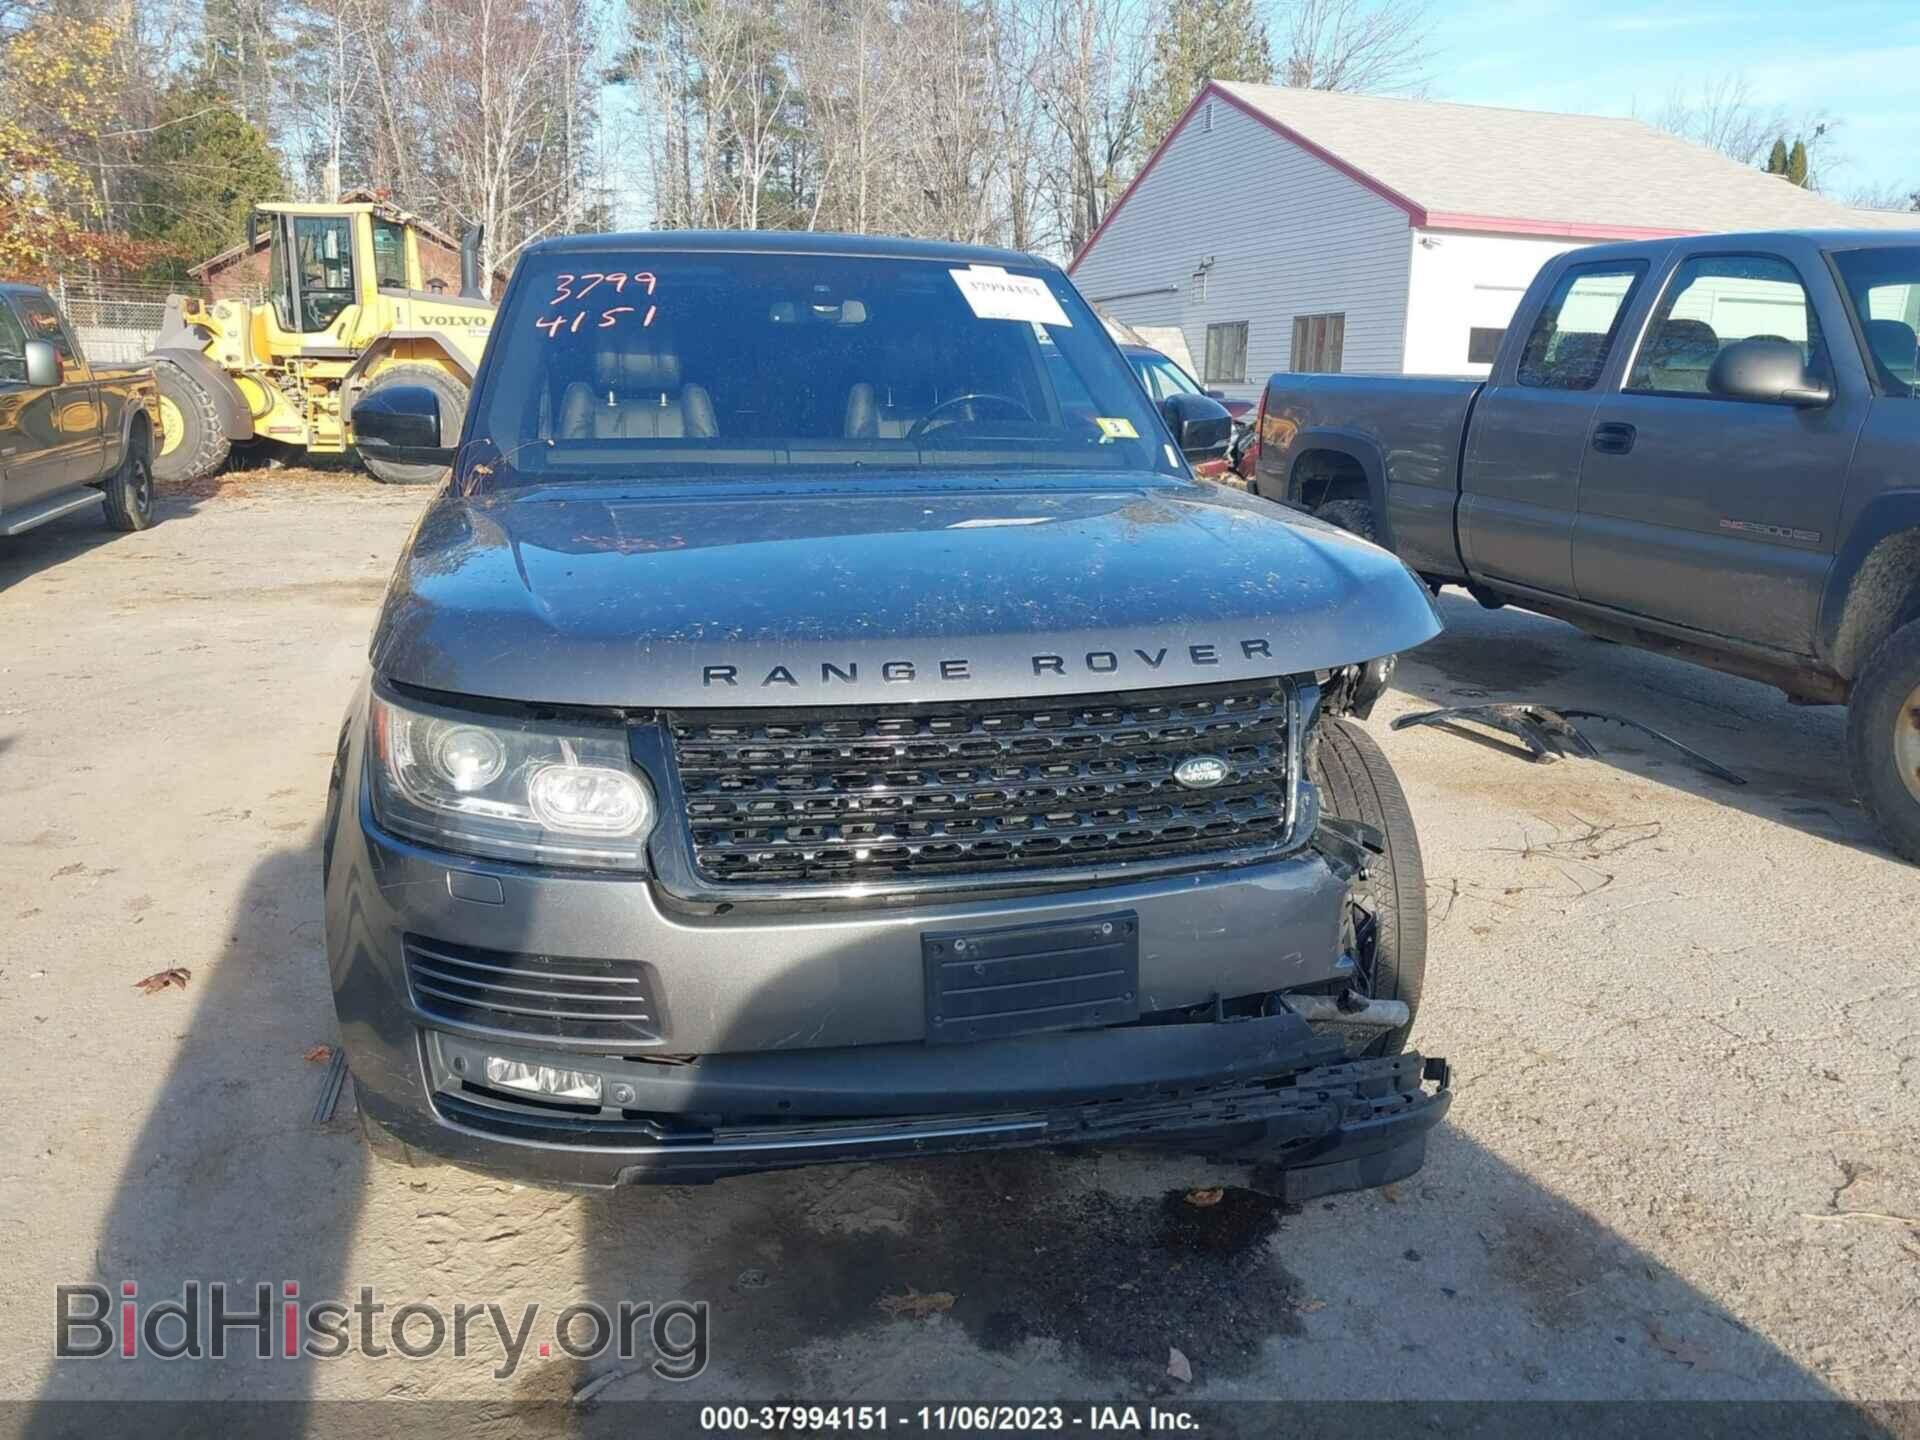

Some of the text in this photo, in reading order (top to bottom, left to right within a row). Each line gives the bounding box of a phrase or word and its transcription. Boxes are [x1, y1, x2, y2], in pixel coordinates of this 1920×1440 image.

[549, 271, 657, 305] 3799
[419, 315, 487, 327] VOLVO
[535, 304, 657, 338] 4151
[702, 638, 1274, 688] RANGE ROVER
